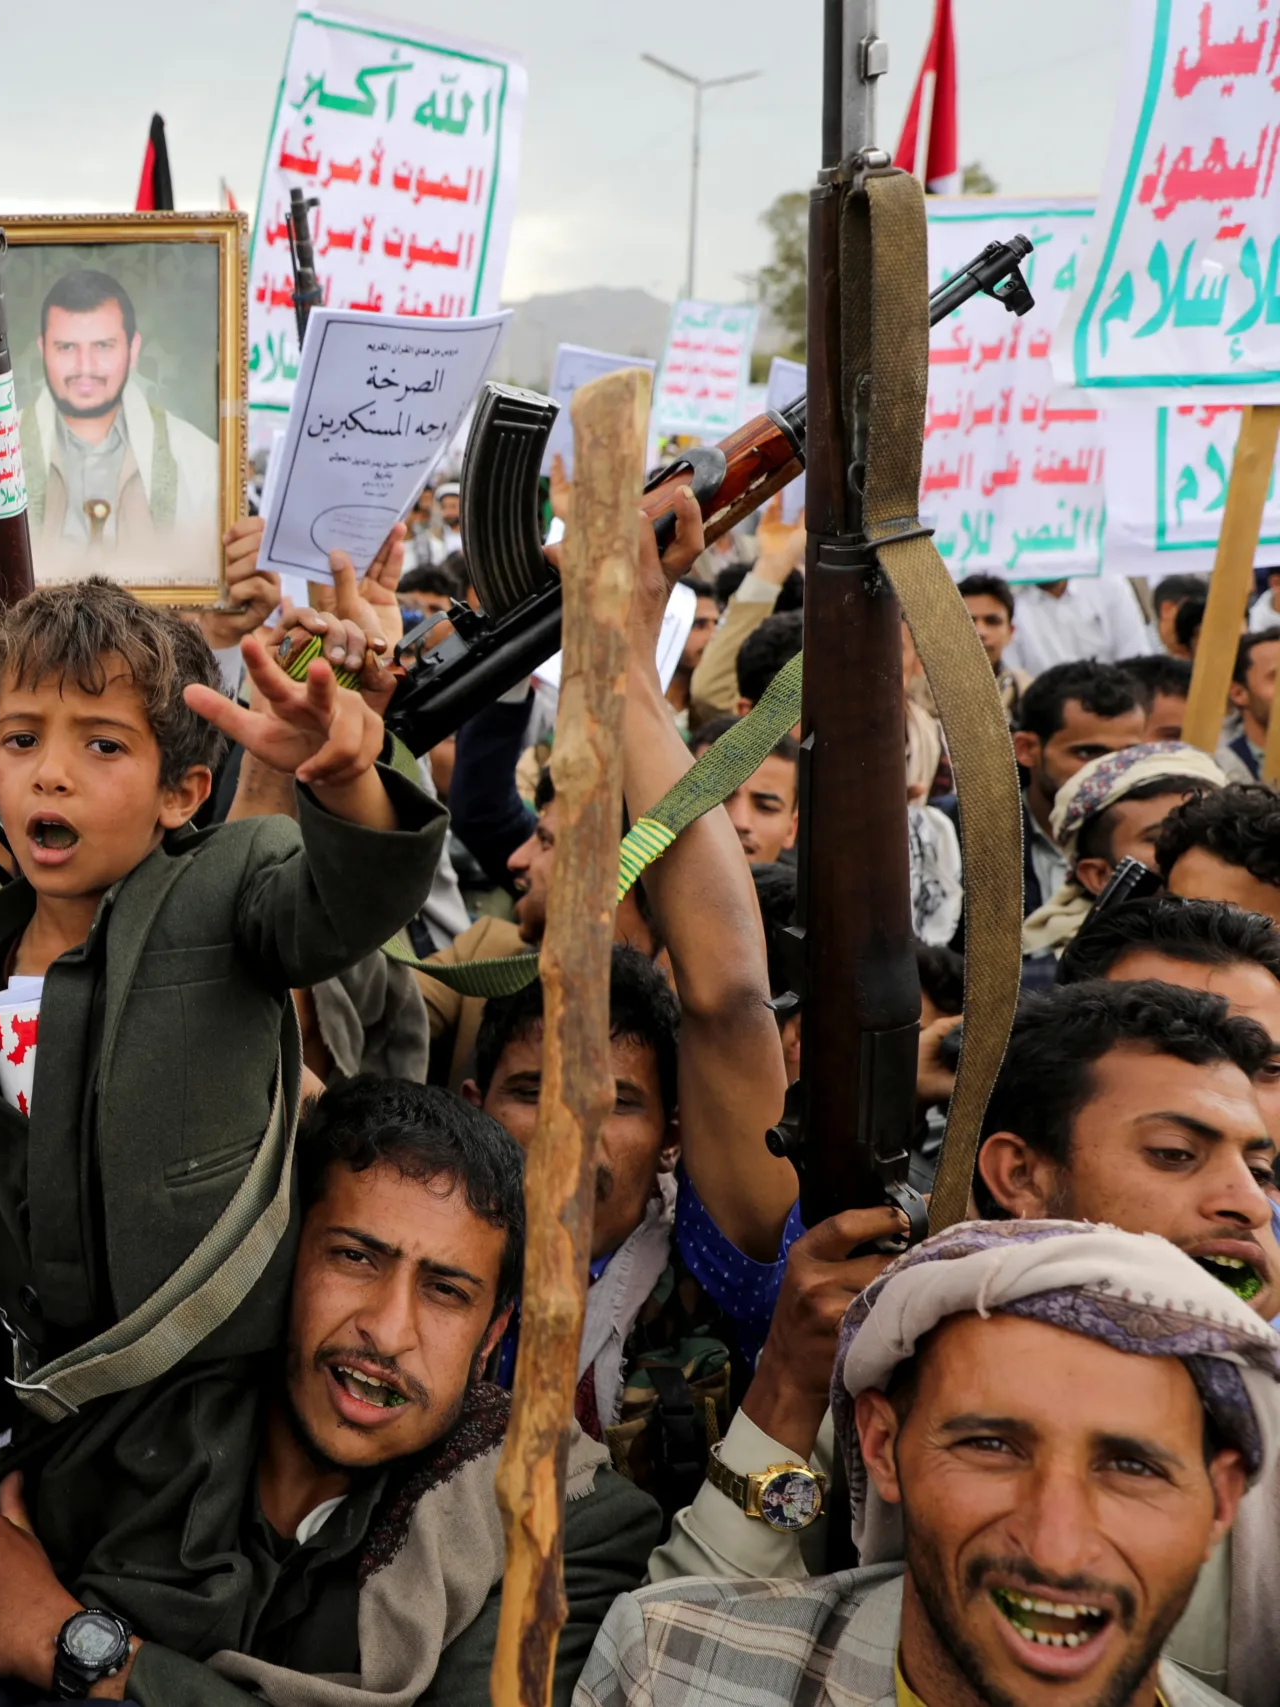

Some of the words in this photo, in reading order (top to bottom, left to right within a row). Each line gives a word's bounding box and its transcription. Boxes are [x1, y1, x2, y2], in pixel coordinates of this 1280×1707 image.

[414, 72, 492, 136] الله
[392, 162, 483, 205] الموت
[266, 200, 376, 264] لإسرايل
[383, 227, 474, 271] الموت
[1100, 232, 1280, 363] لإسلام
[366, 364, 446, 402] الصرخة
[307, 400, 412, 443] المستكبرين
[1006, 499, 1094, 571] النصر
